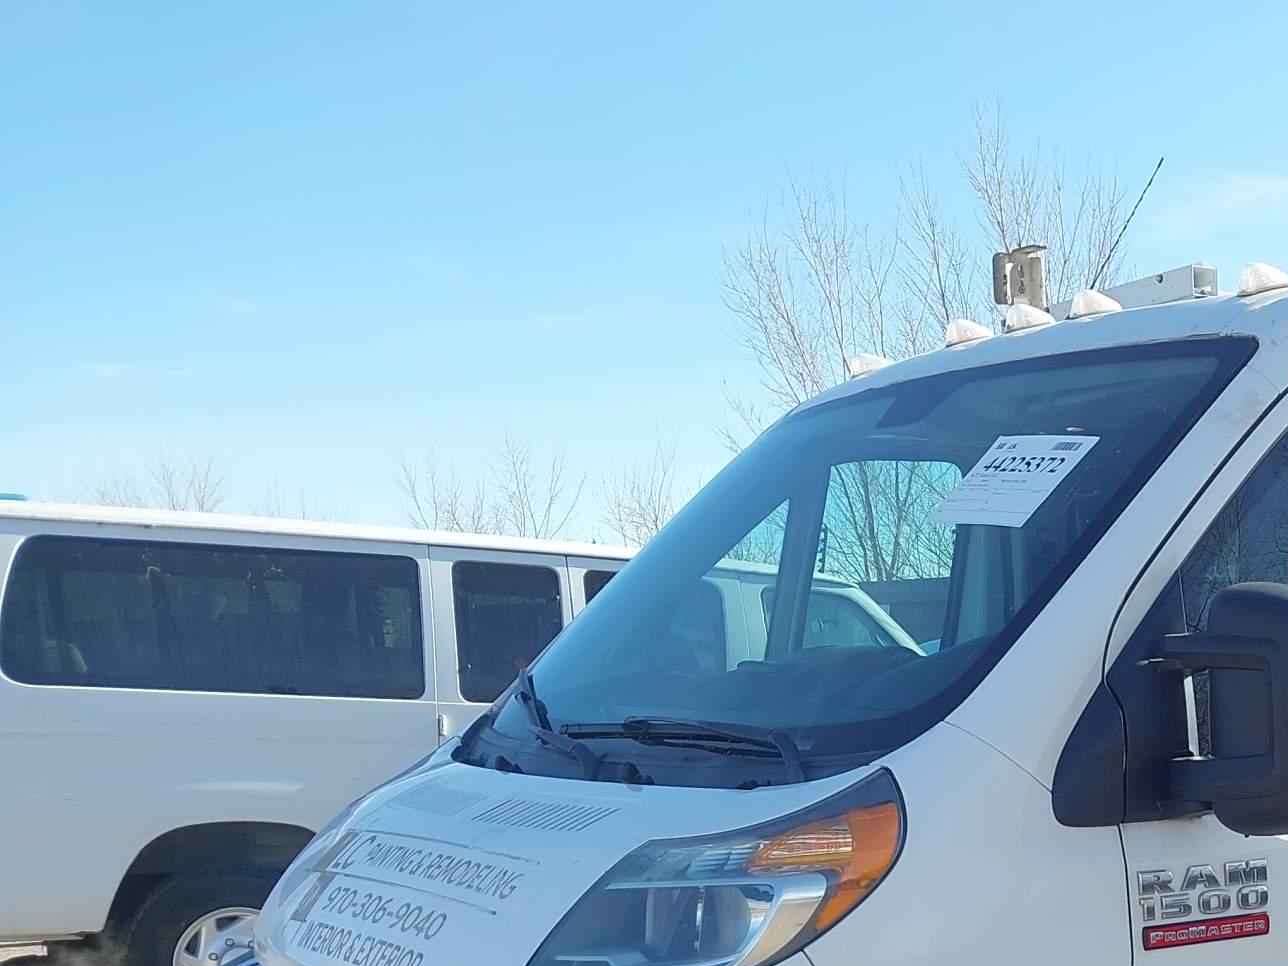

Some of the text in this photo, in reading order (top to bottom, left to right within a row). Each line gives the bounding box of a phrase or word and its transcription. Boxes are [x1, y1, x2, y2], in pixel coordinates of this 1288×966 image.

[983, 456, 1067, 473] 44225372
[331, 833, 377, 870] LC
[363, 843, 422, 875] PAINTING
[418, 853, 525, 901] REMODELING
[1136, 857, 1268, 896] RAM
[322, 886, 447, 940] 970-306-9040
[1139, 884, 1269, 922] 1500
[297, 919, 353, 962] INTERIOR
[343, 932, 363, 962] &
